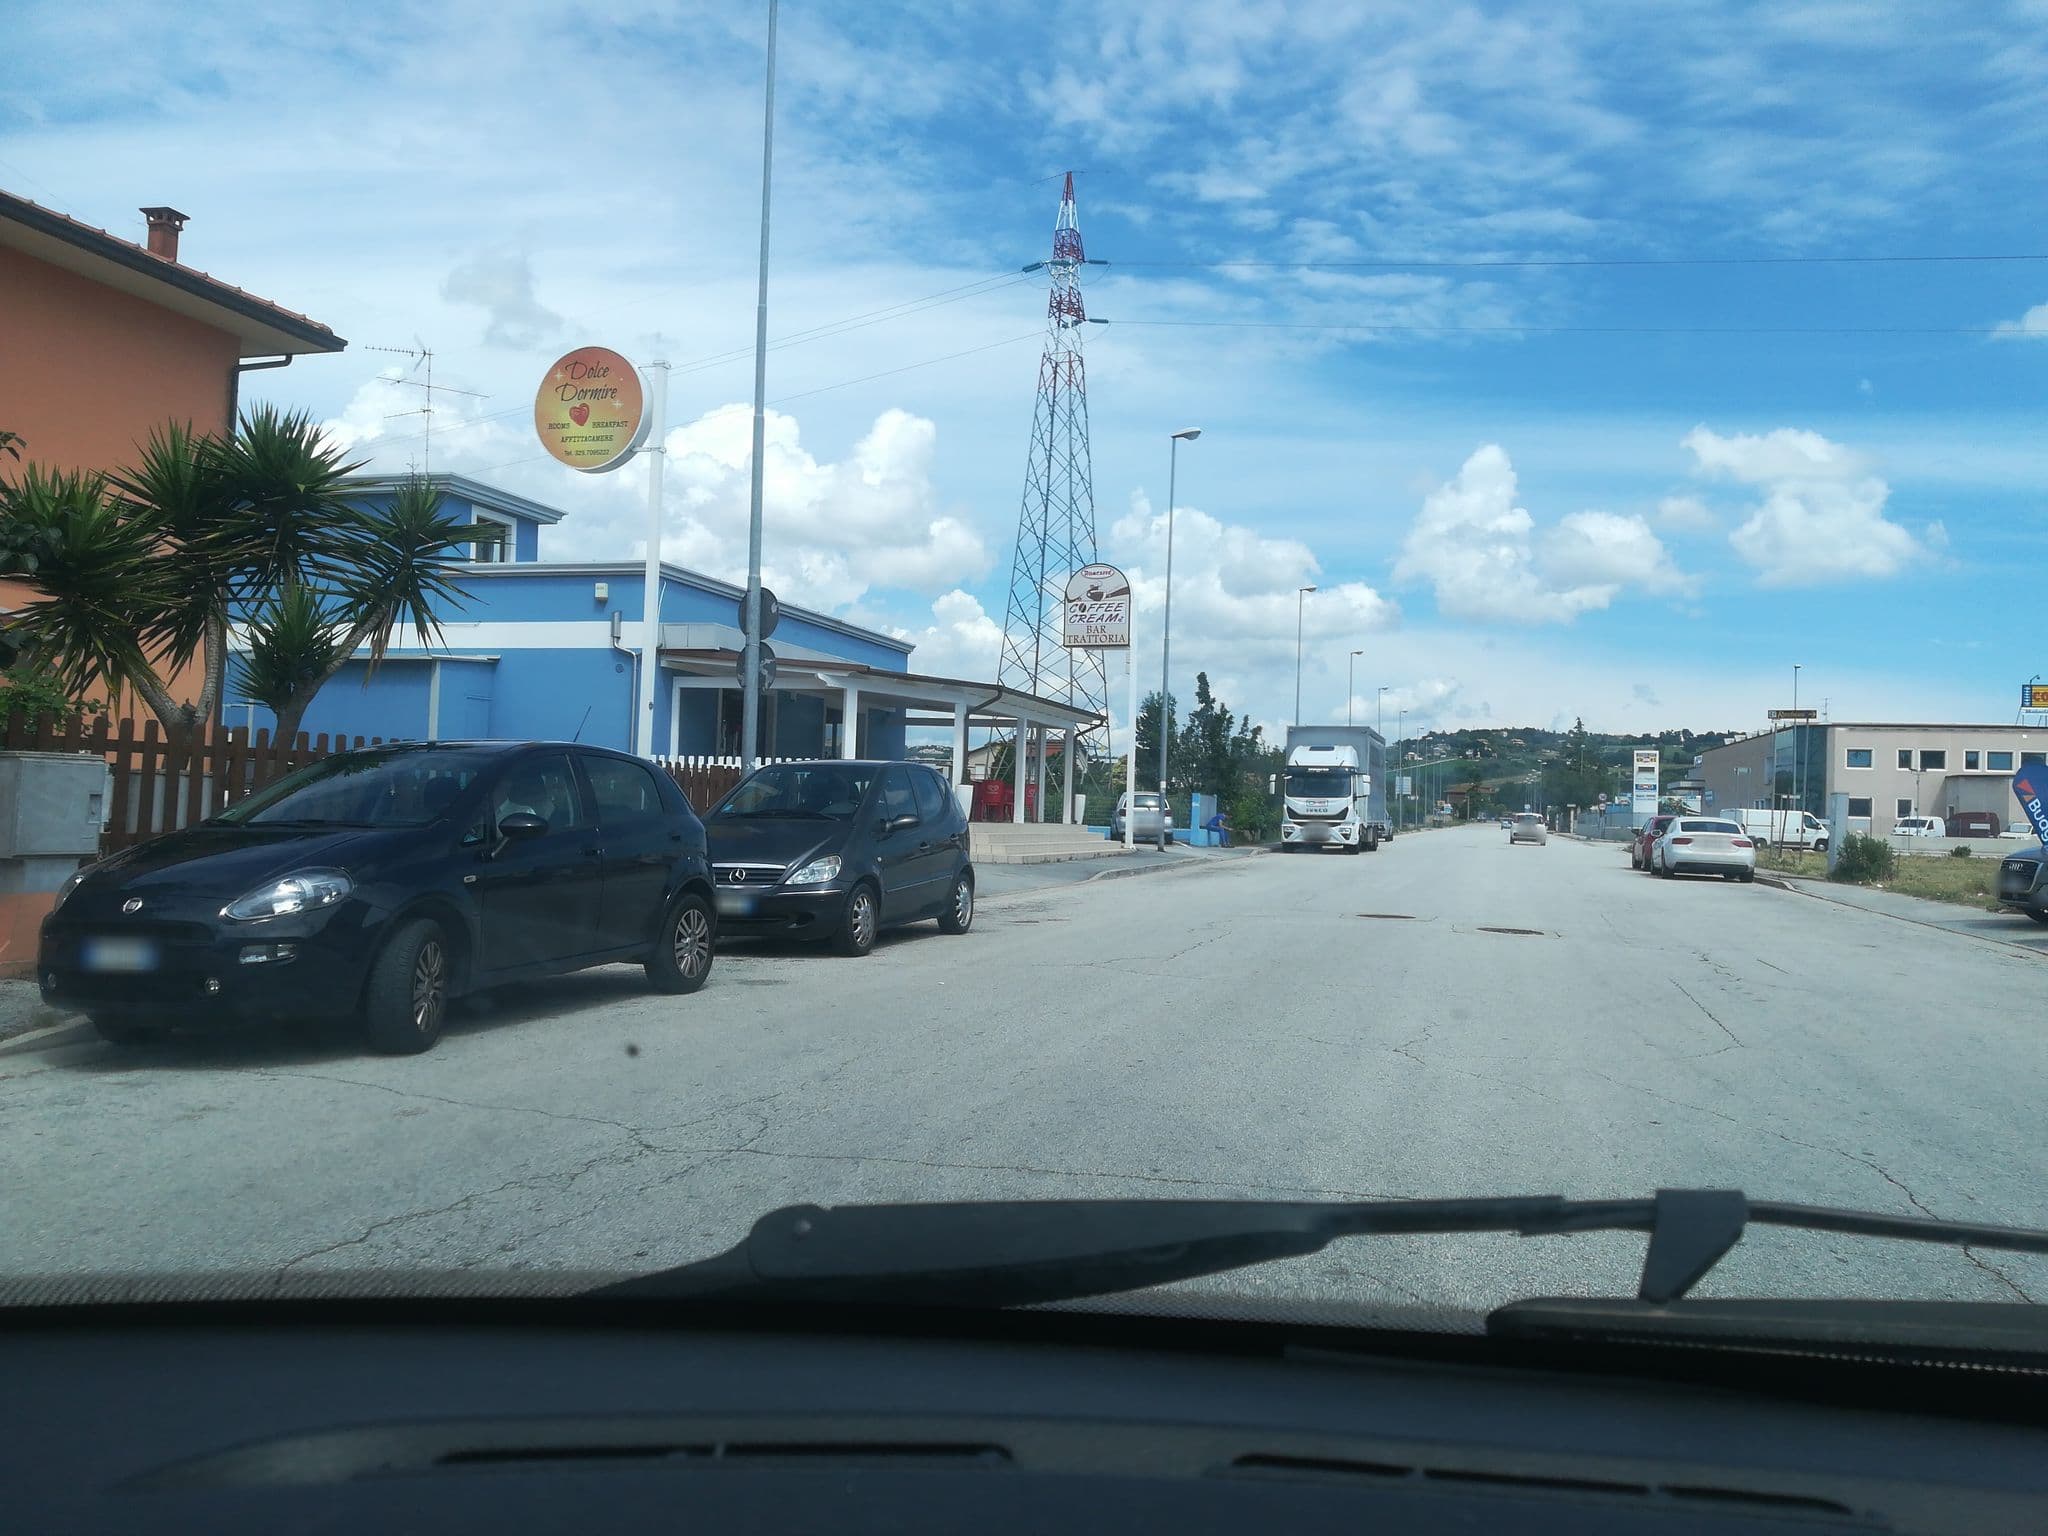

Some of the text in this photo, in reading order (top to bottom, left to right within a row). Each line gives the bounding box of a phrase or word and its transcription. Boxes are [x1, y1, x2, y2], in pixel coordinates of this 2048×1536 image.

[565, 361, 609, 380] Dolce
[555, 383, 617, 401] Dormire
[548, 420, 629, 430] ROOMS BREAKFAST
[1069, 602, 1125, 614] COFFEE
[1086, 625, 1106, 634] BAR
[1067, 634, 1126, 644] TRATTORIA
